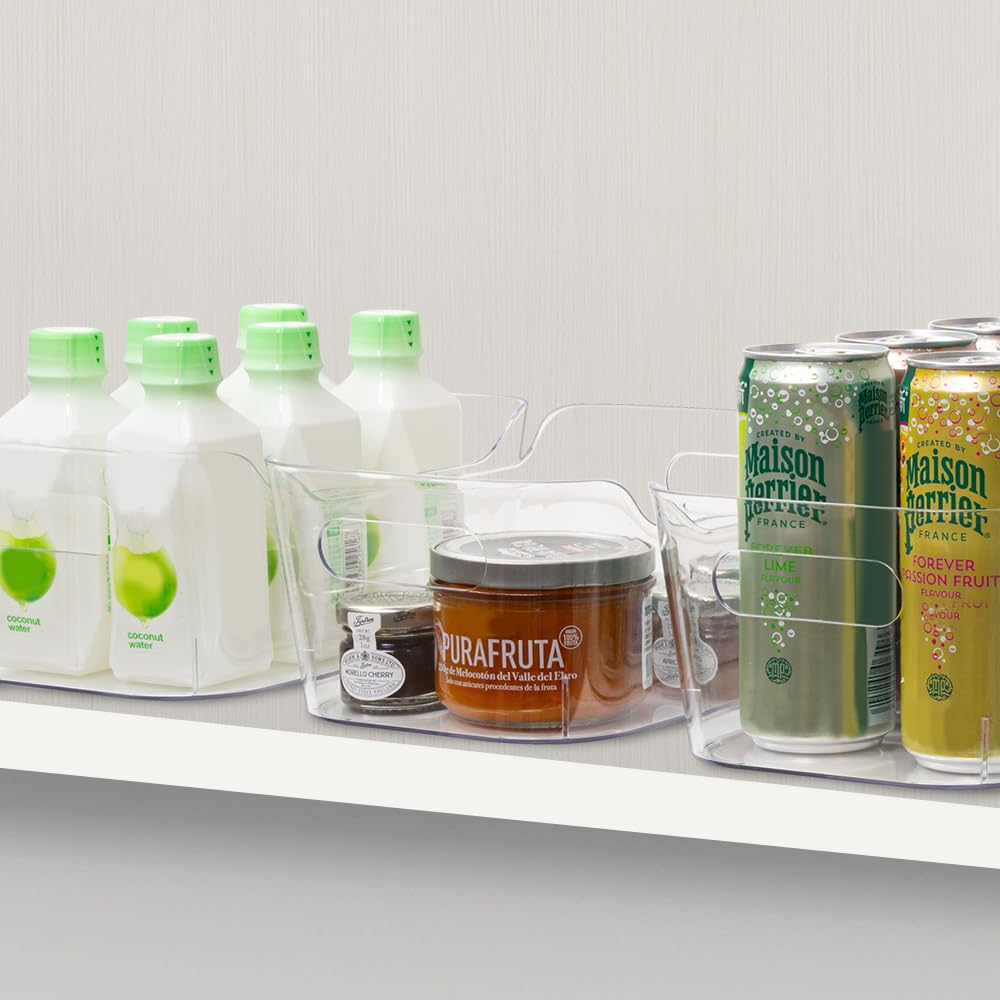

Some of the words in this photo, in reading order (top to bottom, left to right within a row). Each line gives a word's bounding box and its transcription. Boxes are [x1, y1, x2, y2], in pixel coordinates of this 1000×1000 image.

[756, 429, 791, 439] CREATED
[794, 433, 806, 443] BY
[917, 440, 952, 449] CREATED
[955, 443, 966, 453] BY
[745, 439, 827, 487] Maison
[906, 448, 988, 499] Maison
[756, 518, 806, 529] FRANCE
[918, 529, 967, 541] FRANCE
[764, 559, 798, 573] LIME
[913, 555, 975, 572] FOREVER
[953, 575, 1000, 587] FRUIT
[920, 588, 962, 599] FLAVOUR
[7, 615, 41, 626] coconut
[8, 623, 31, 633] water
[127, 631, 164, 642] coconut
[128, 640, 153, 649] water
[442, 632, 565, 669] PURAFRUTA
[456, 666, 496, 681] Melocotón
[496, 671, 511, 681] del
[512, 671, 536, 682] Valle
[537, 671, 552, 682] del
[485, 683, 524, 691] procedentes
[524, 683, 533, 691] de
[533, 683, 540, 691] la
[541, 683, 558, 691] fruta
